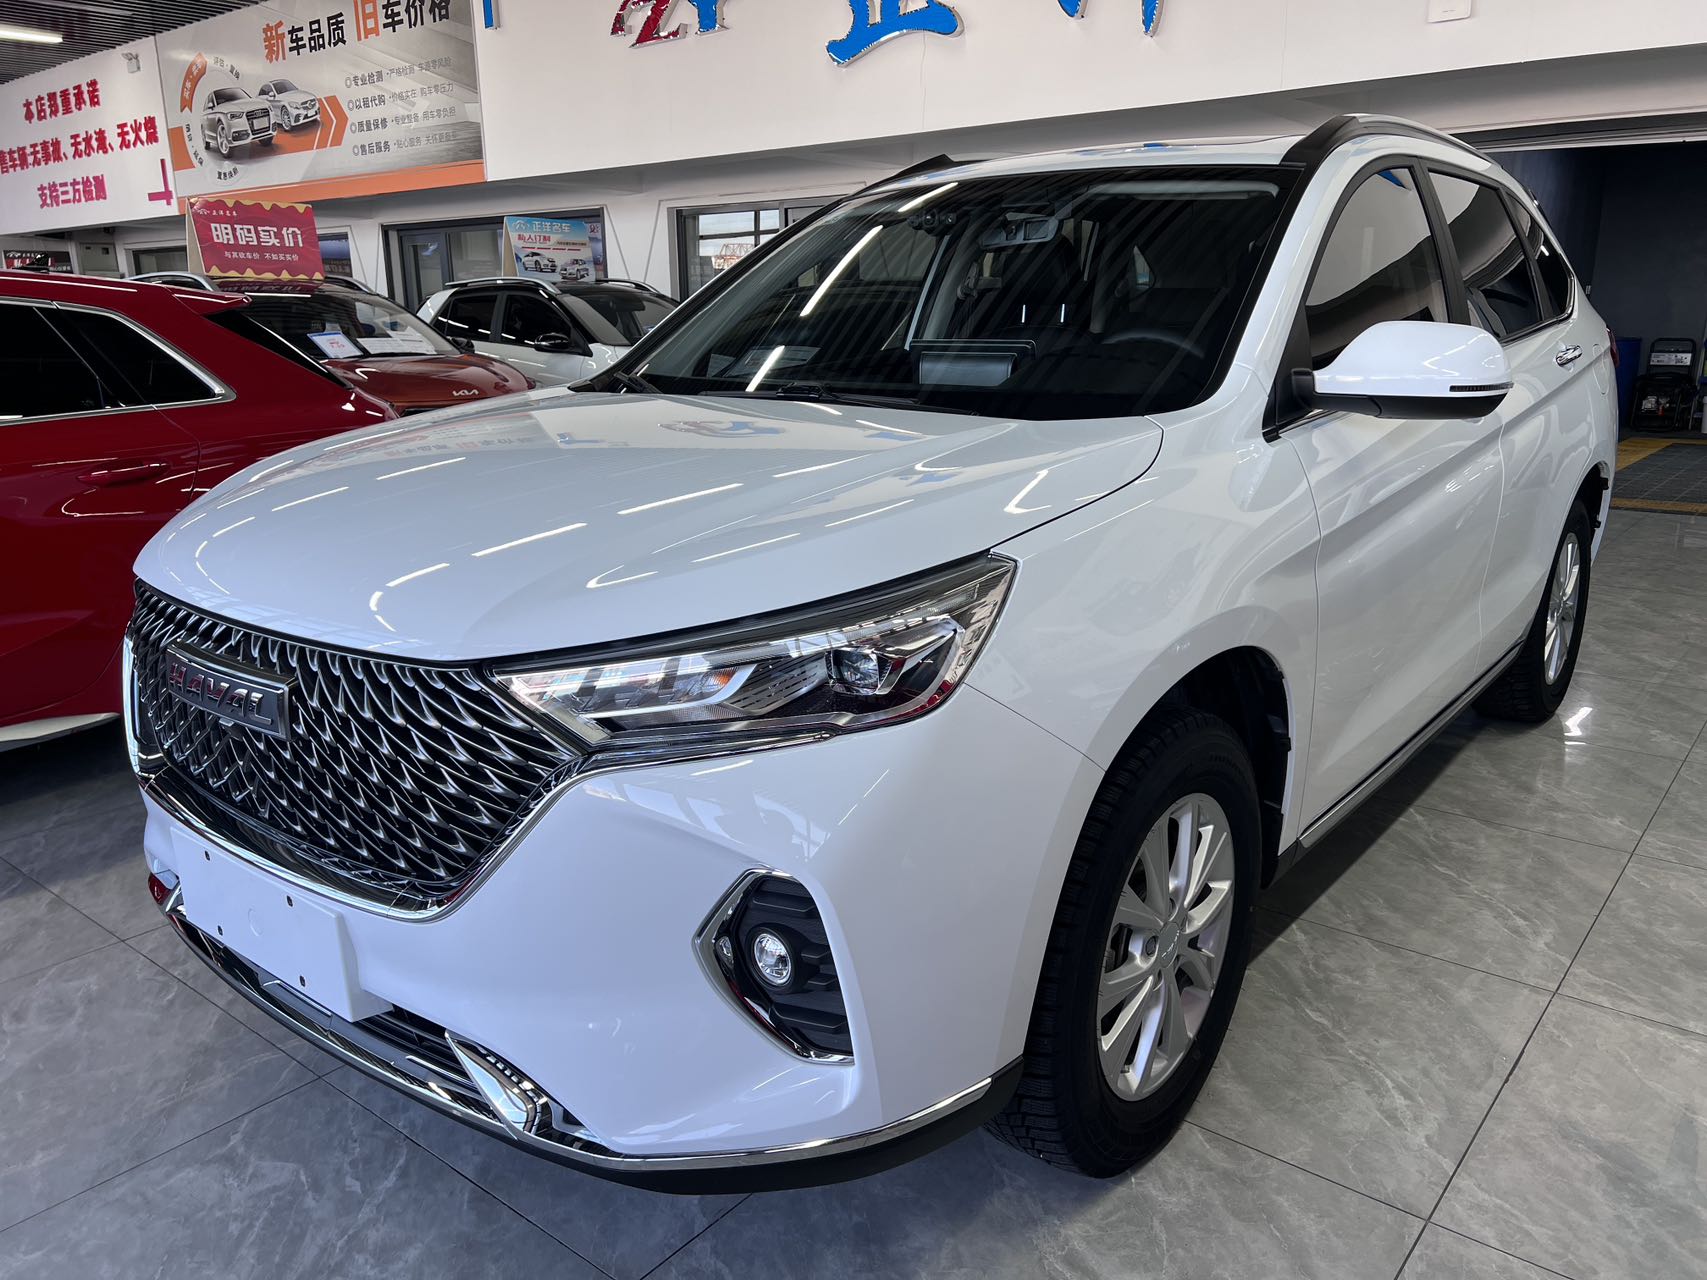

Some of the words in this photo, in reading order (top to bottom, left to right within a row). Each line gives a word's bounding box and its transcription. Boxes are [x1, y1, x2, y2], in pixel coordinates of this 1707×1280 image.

[262, 12, 347, 63] 新车品质
[354, 0, 450, 41] 旧车价格
[352, 70, 384, 87] 专业检测
[23, 78, 101, 124] 本店郑重承诺
[355, 94, 386, 110] 以租代购
[357, 117, 388, 133] 质量保修
[359, 140, 391, 156] 售后服务
[37, 174, 108, 209] 支持三方检测
[210, 223, 304, 248] 明码实价
[532, 221, 571, 233] 正洋名车
